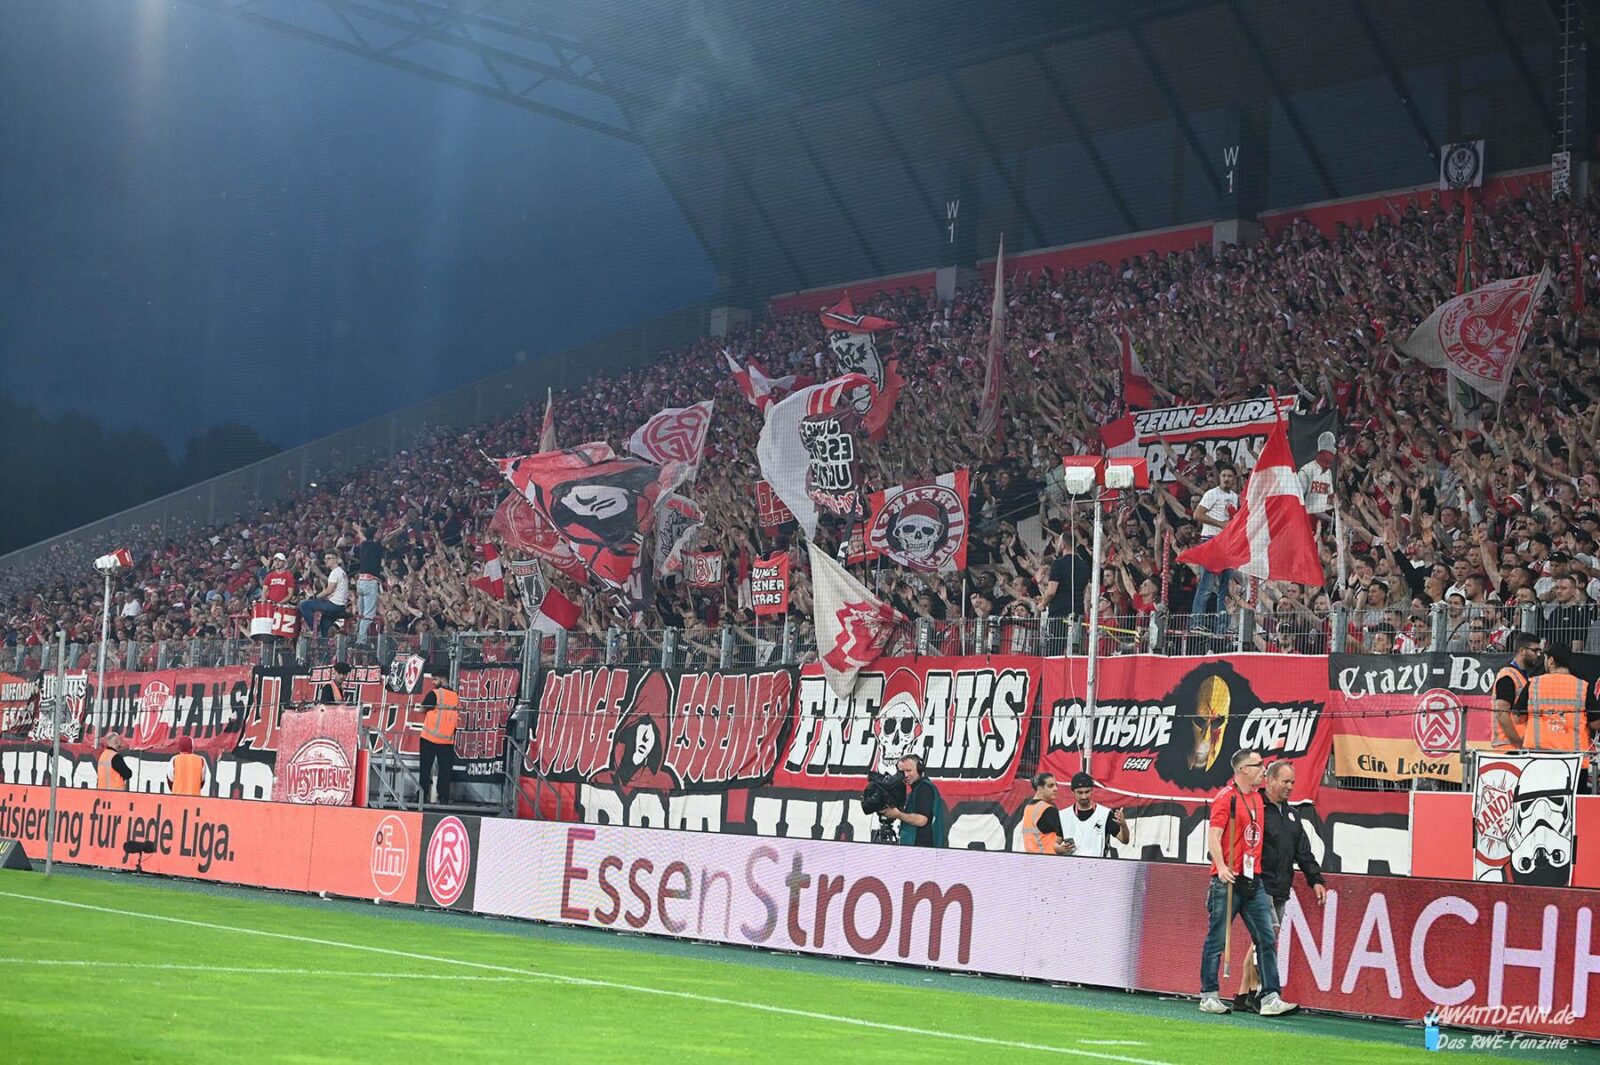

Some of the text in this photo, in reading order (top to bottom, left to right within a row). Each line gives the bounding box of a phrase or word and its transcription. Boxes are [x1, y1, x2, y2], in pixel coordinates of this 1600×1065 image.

[1224, 146, 1239, 167] W
[1226, 170, 1233, 193] 1
[946, 200, 960, 219] W
[948, 222, 955, 243] 1
[168, 680, 251, 740] FANS
[524, 667, 629, 776] JUNGE
[665, 670, 792, 783] ESSENER
[1239, 707, 1318, 753] CREW
[1122, 757, 1152, 772] ESSEN
[1357, 754, 1450, 777] Ein Leben
[90, 798, 121, 849] für
[123, 803, 173, 864] jede
[180, 807, 235, 873] Liga.
[560, 827, 974, 965] EssenStrom
